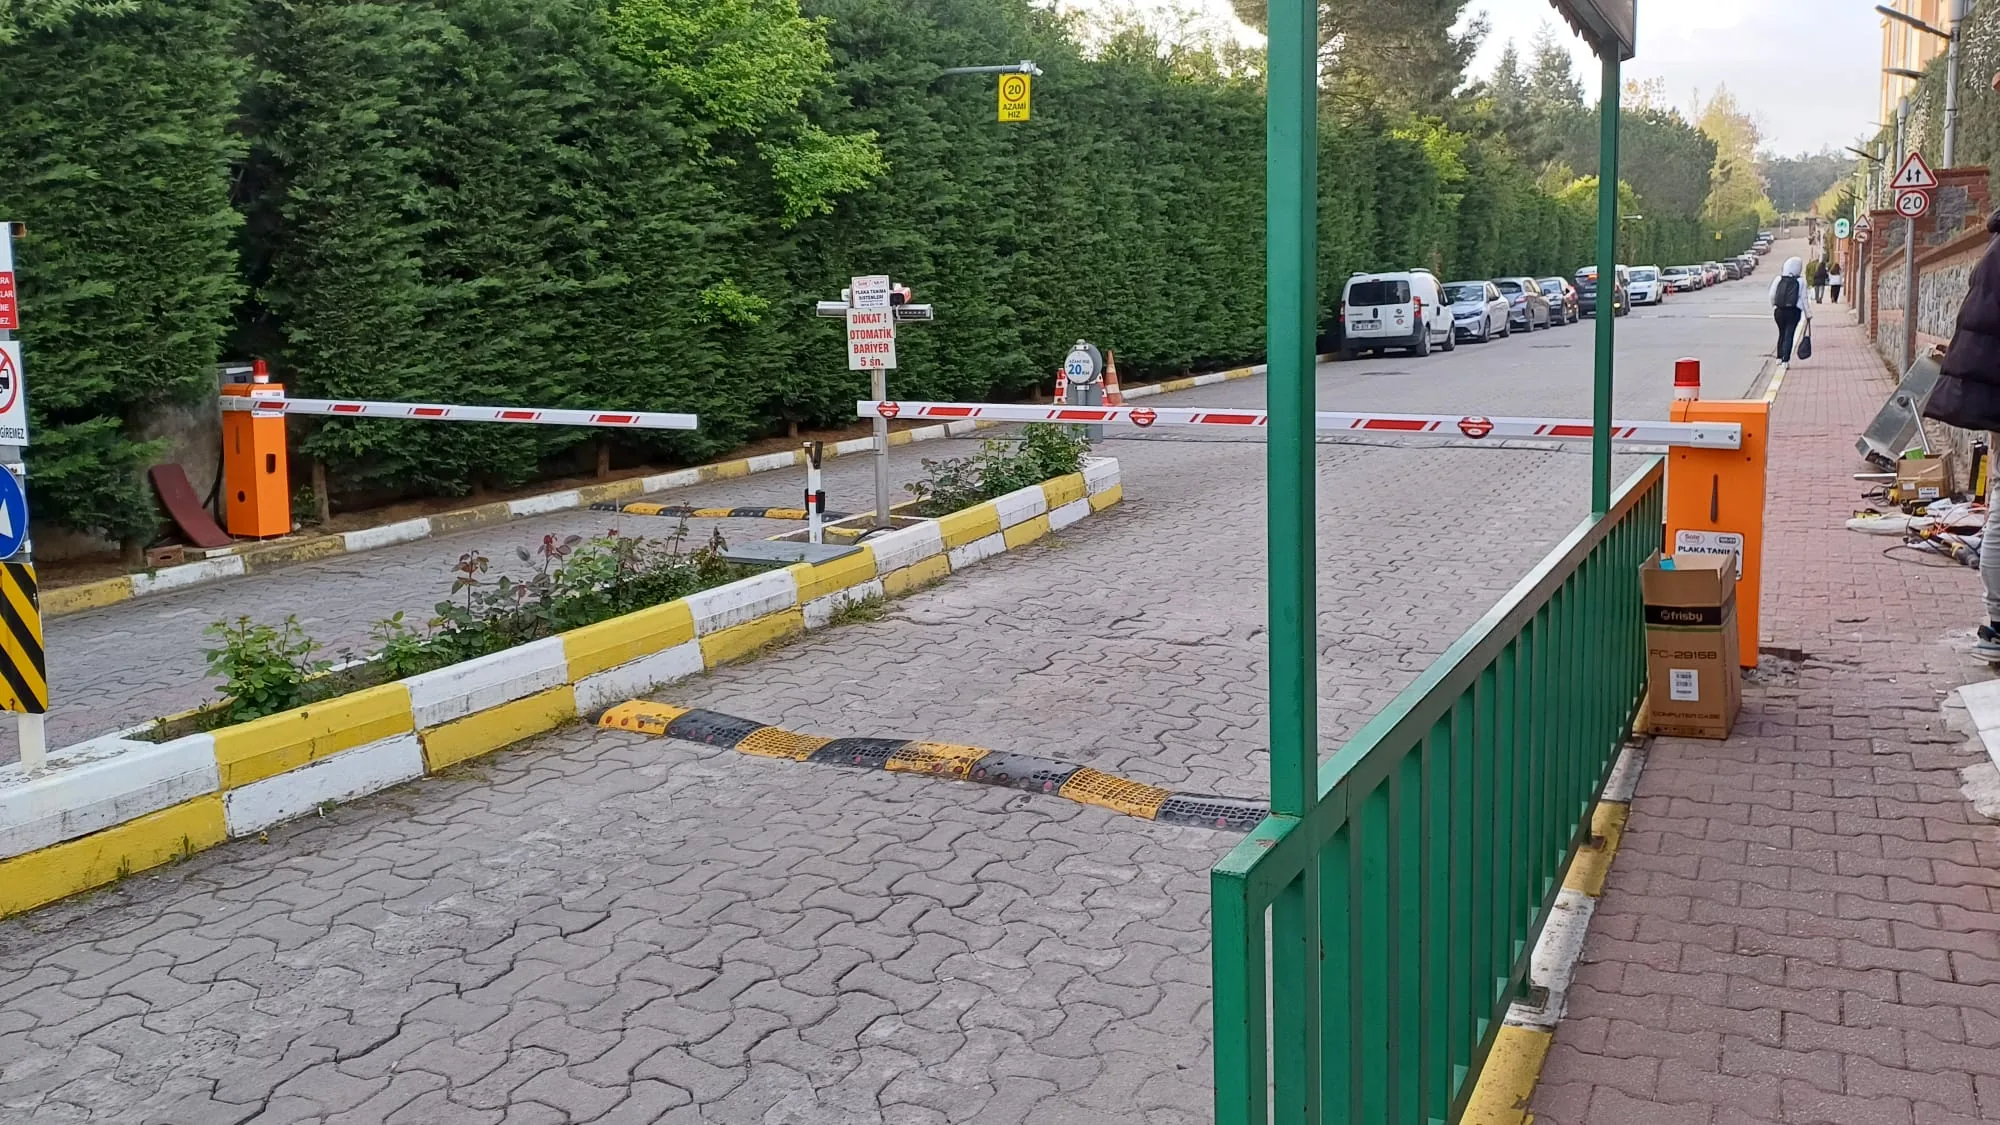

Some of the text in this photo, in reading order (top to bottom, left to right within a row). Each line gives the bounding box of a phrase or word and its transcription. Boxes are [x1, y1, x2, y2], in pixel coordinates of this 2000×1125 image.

[1008, 85, 1021, 94] 20
[1903, 197, 1922, 209] 20
[852, 312, 887, 324] DİKKAT !
[849, 327, 893, 340] OTOMATİK
[861, 357, 867, 366] 5
[1068, 364, 1082, 375] 20
[1678, 545, 1740, 556] PLAKA TANIA
[1671, 611, 1703, 623] frisby
